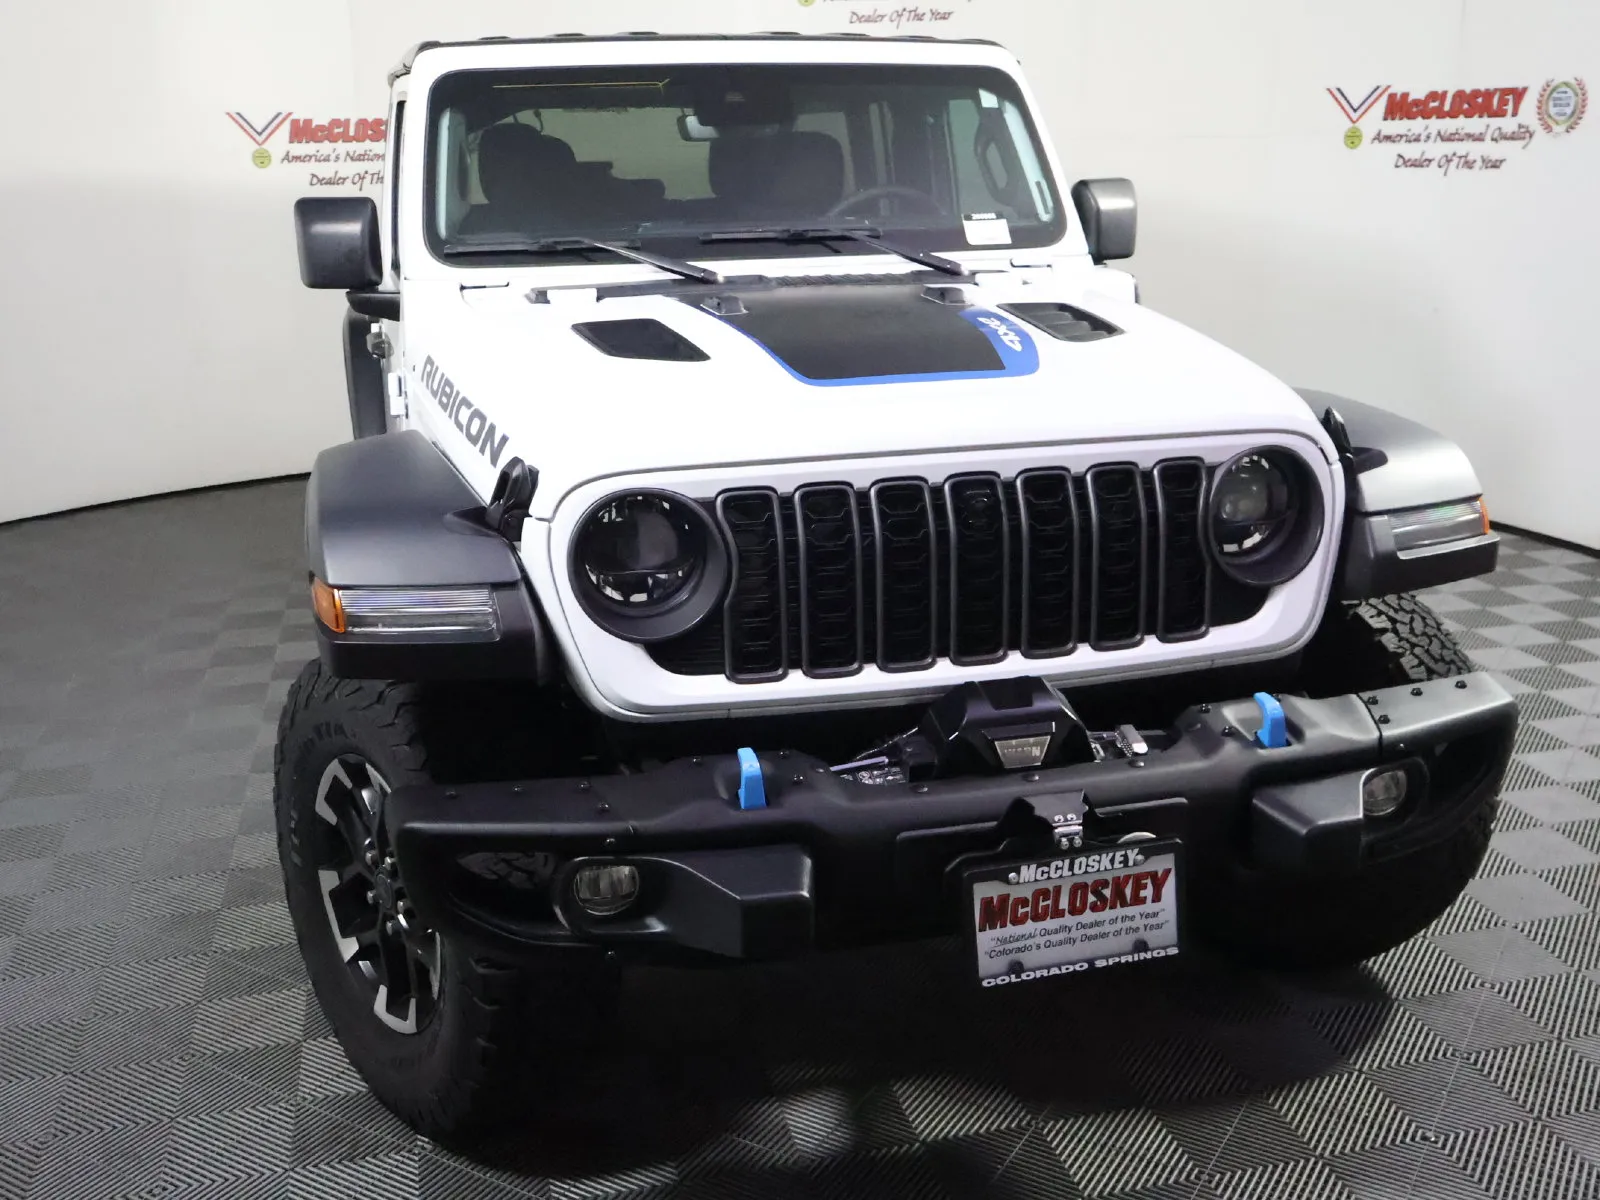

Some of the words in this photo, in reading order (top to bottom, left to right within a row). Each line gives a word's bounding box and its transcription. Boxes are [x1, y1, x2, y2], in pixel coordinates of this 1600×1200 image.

[849, 8, 886, 24] Dealer
[889, 7, 907, 30] Of
[906, 6, 925, 22] The
[929, 8, 954, 22] Year
[1382, 86, 1528, 121] McCLOSKEY
[1370, 125, 1431, 145] America's
[1433, 124, 1488, 143] National
[1490, 123, 1537, 149] Quality
[280, 148, 340, 163] America's
[1394, 151, 1435, 169] Dealer
[1437, 151, 1457, 177] Of
[1456, 151, 1477, 170] The
[1480, 154, 1506, 170] Year
[309, 171, 349, 186] Dealer
[351, 170, 369, 191] Of
[421, 354, 510, 469] RUBICON
[1019, 848, 1139, 884] McCLOSKEY
[978, 868, 1172, 932] McCLOSKEY
[1039, 923, 1073, 937] Quality
[1075, 919, 1106, 931] Dealer
[1108, 917, 1120, 926] of
[1121, 913, 1137, 924] the
[1044, 936, 1077, 949] Quality
[1080, 931, 1111, 942] Dealer
[1112, 926, 1124, 936] of
[1125, 924, 1140, 935] the
[981, 961, 1089, 988] COLORADO
[1094, 946, 1180, 969] SPRINGS
